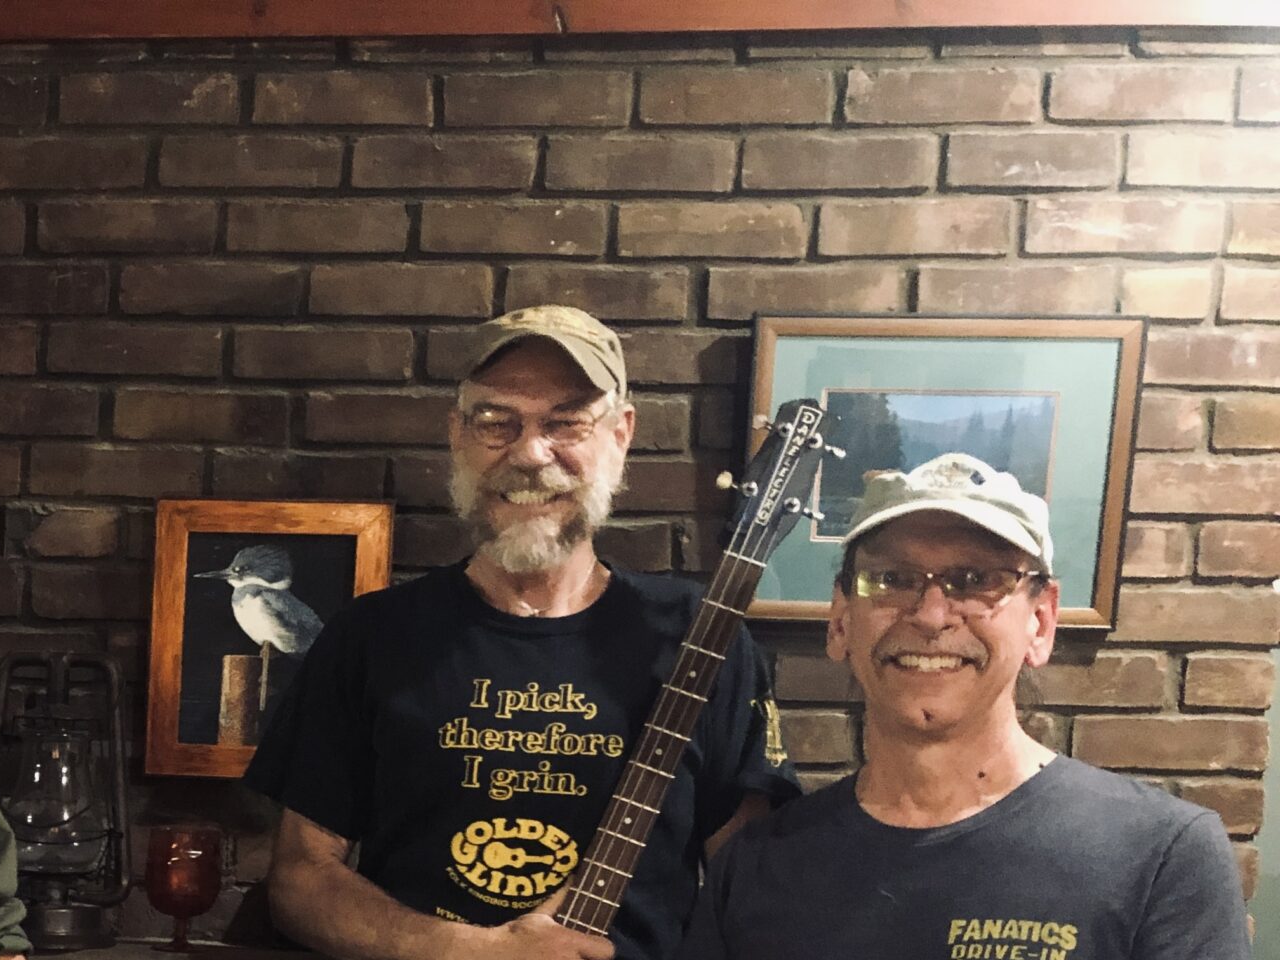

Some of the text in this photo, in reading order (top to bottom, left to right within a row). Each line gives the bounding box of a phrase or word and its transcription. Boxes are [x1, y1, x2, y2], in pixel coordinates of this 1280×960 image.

[757, 411, 815, 520] DANELECTRO
[470, 678, 597, 720] I pick,
[438, 717, 624, 757] therefore
[461, 755, 587, 800] I grin.
[947, 918, 1078, 951] FANATICS
